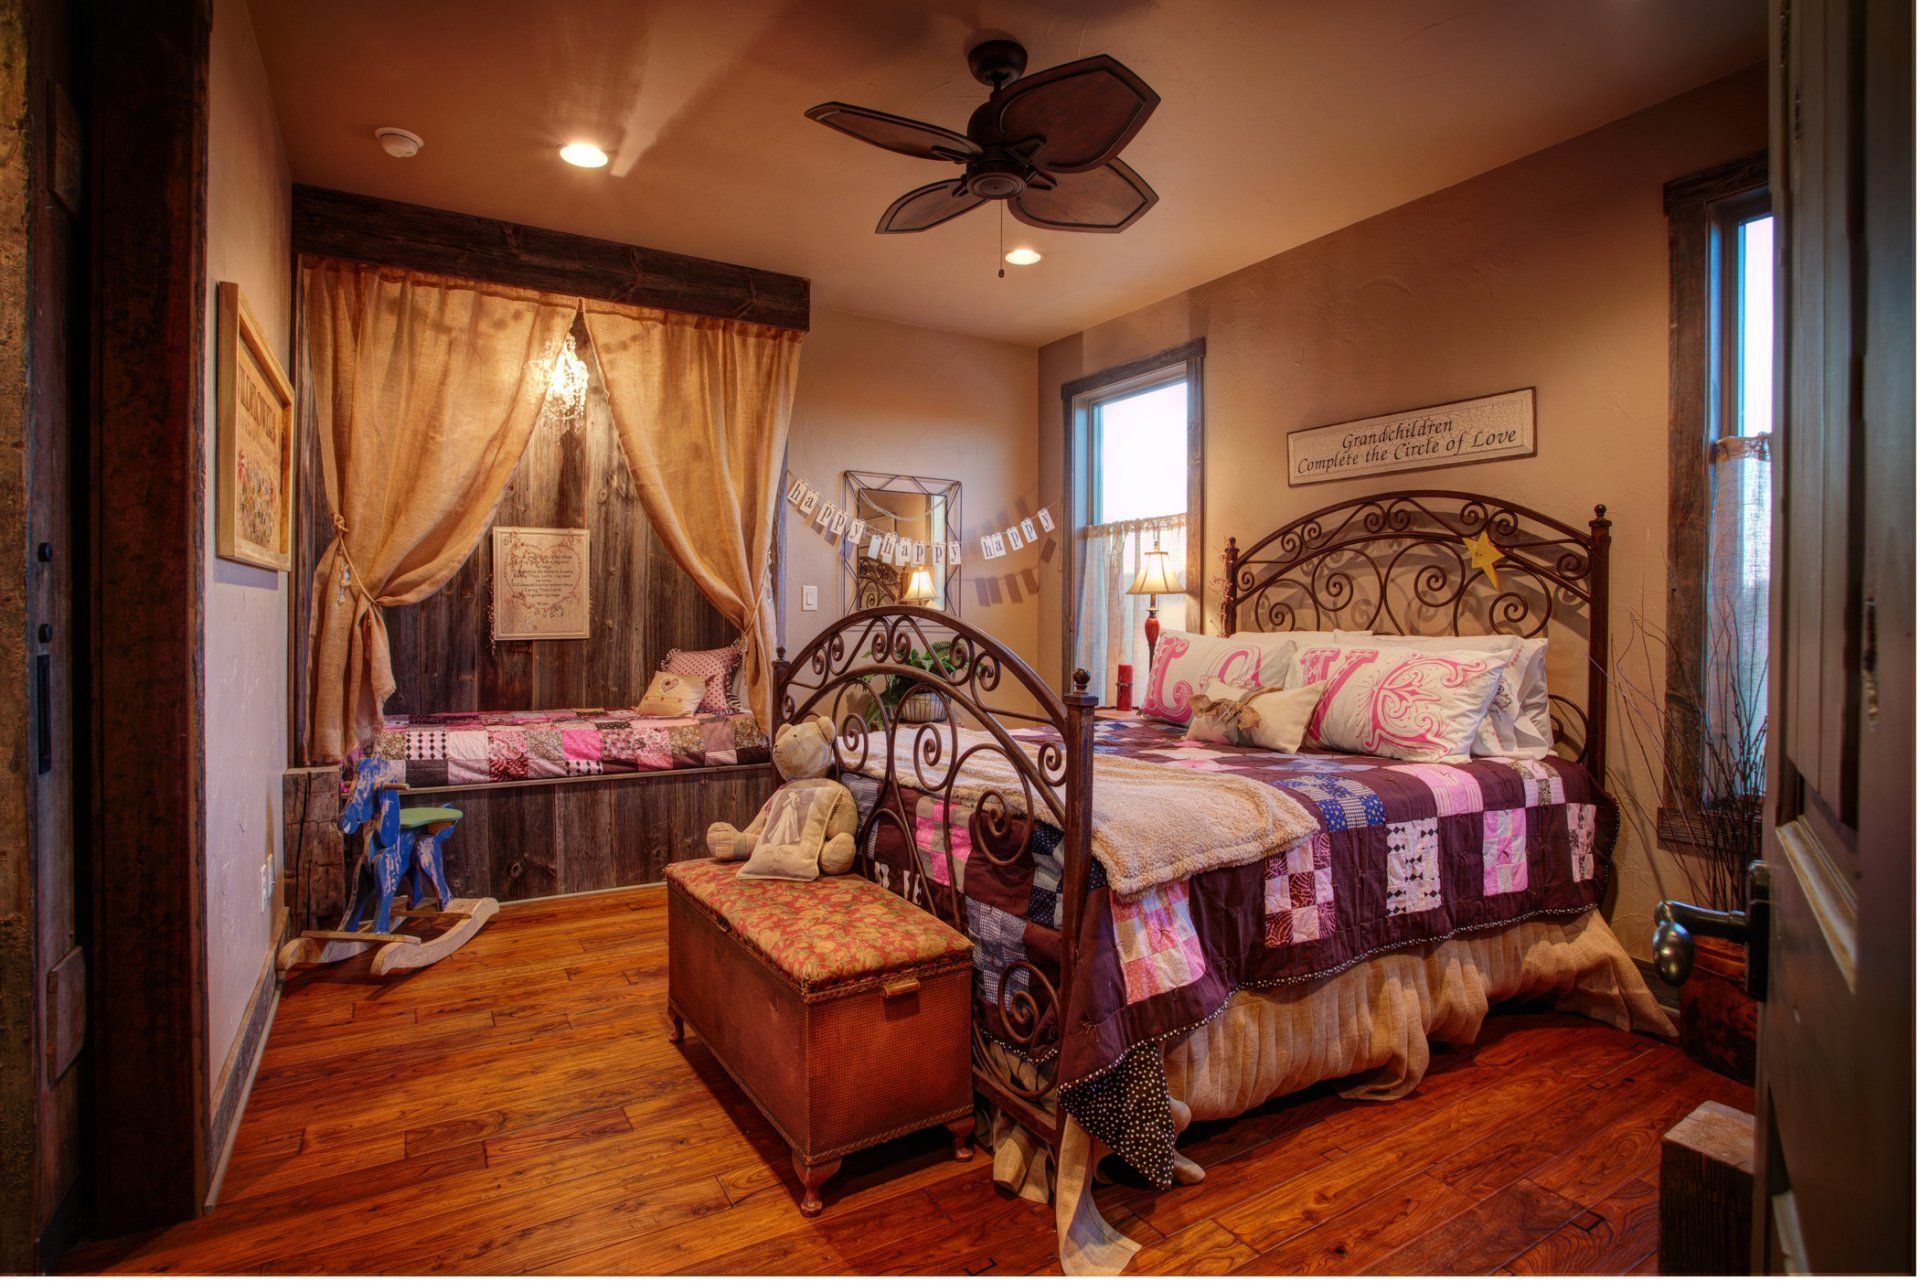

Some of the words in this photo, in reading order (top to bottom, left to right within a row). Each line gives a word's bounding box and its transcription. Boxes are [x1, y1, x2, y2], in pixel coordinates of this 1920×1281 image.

[1297, 451, 1359, 474] Complete
[1365, 446, 1388, 463] the
[1394, 440, 1440, 461] Circle
[1446, 435, 1468, 456] of
[1470, 428, 1517, 448] Love
[1342, 418, 1453, 451] Grandchildren
[789, 482, 863, 541] happy
[881, 535, 960, 564] happy
[982, 511, 1053, 558] happy
